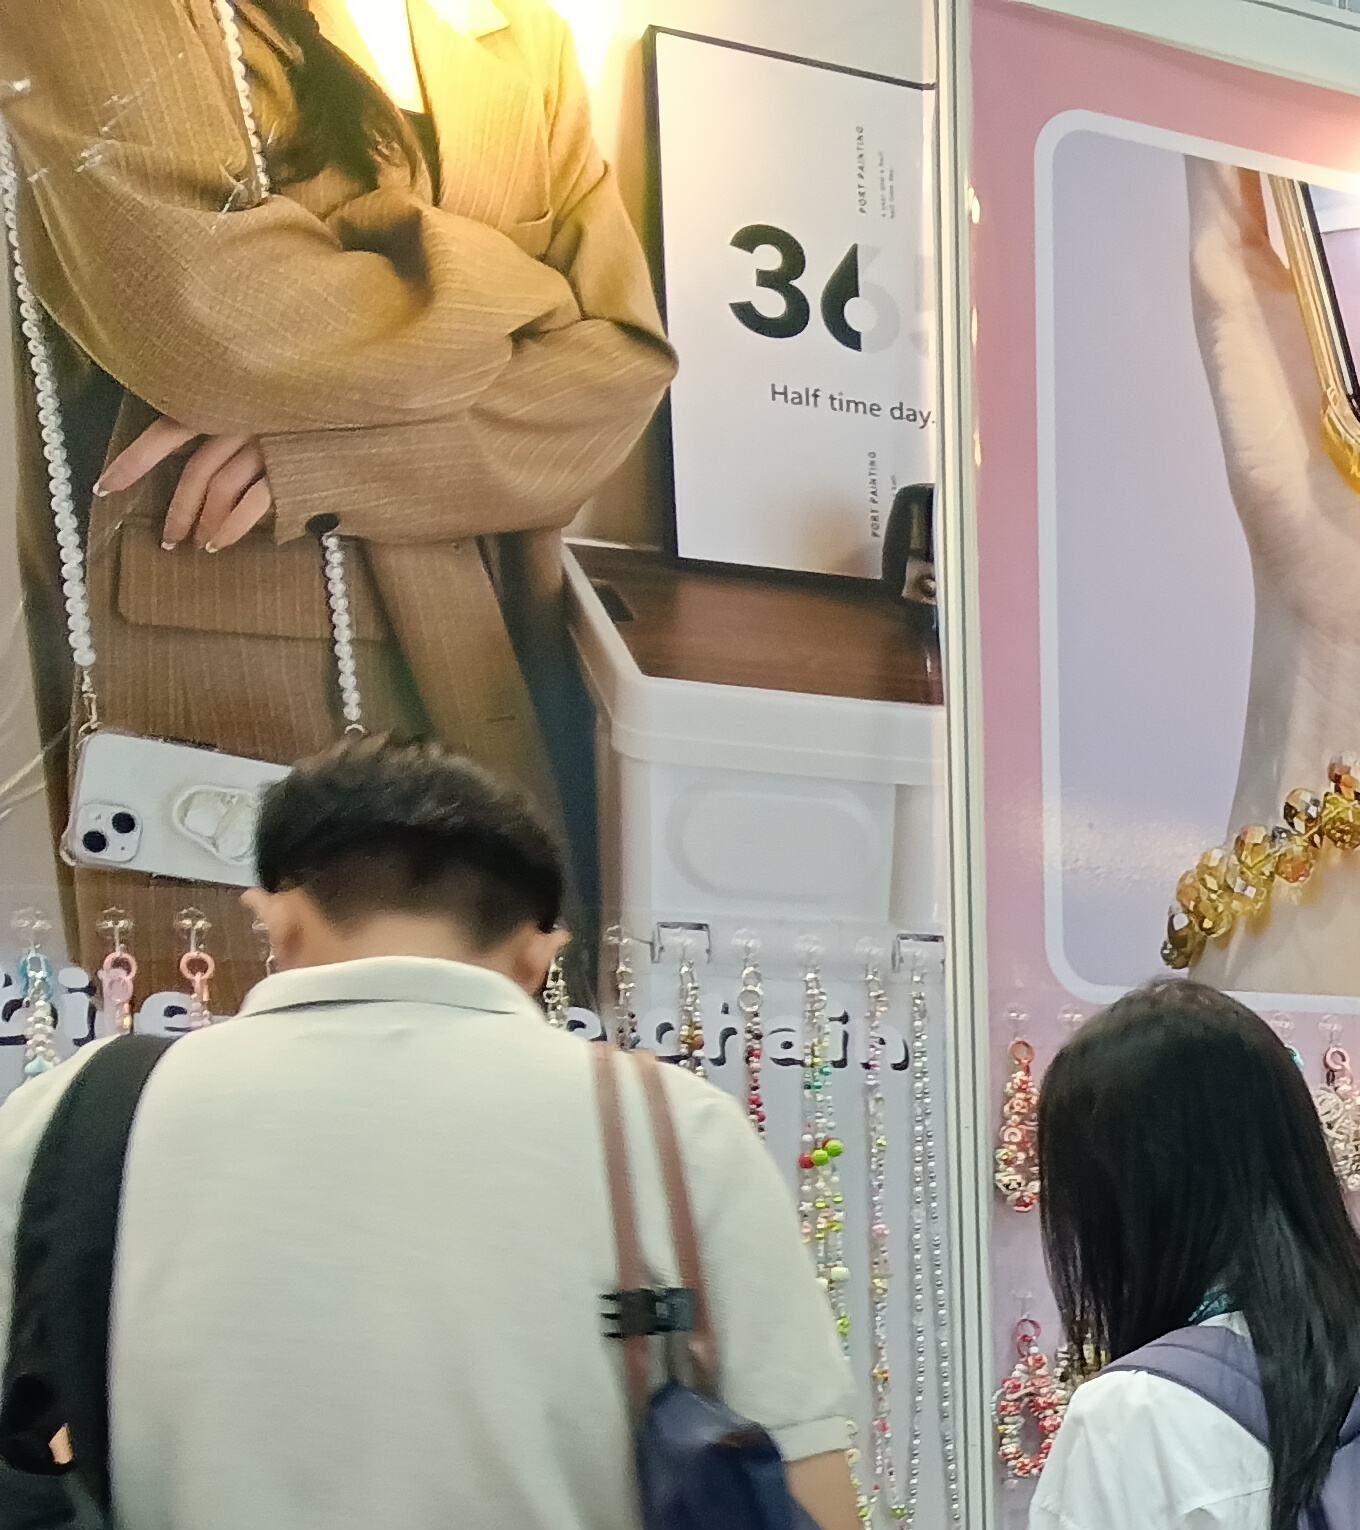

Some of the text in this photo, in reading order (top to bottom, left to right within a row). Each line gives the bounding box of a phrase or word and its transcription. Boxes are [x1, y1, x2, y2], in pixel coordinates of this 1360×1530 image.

[770, 383, 936, 429] Half time day.
